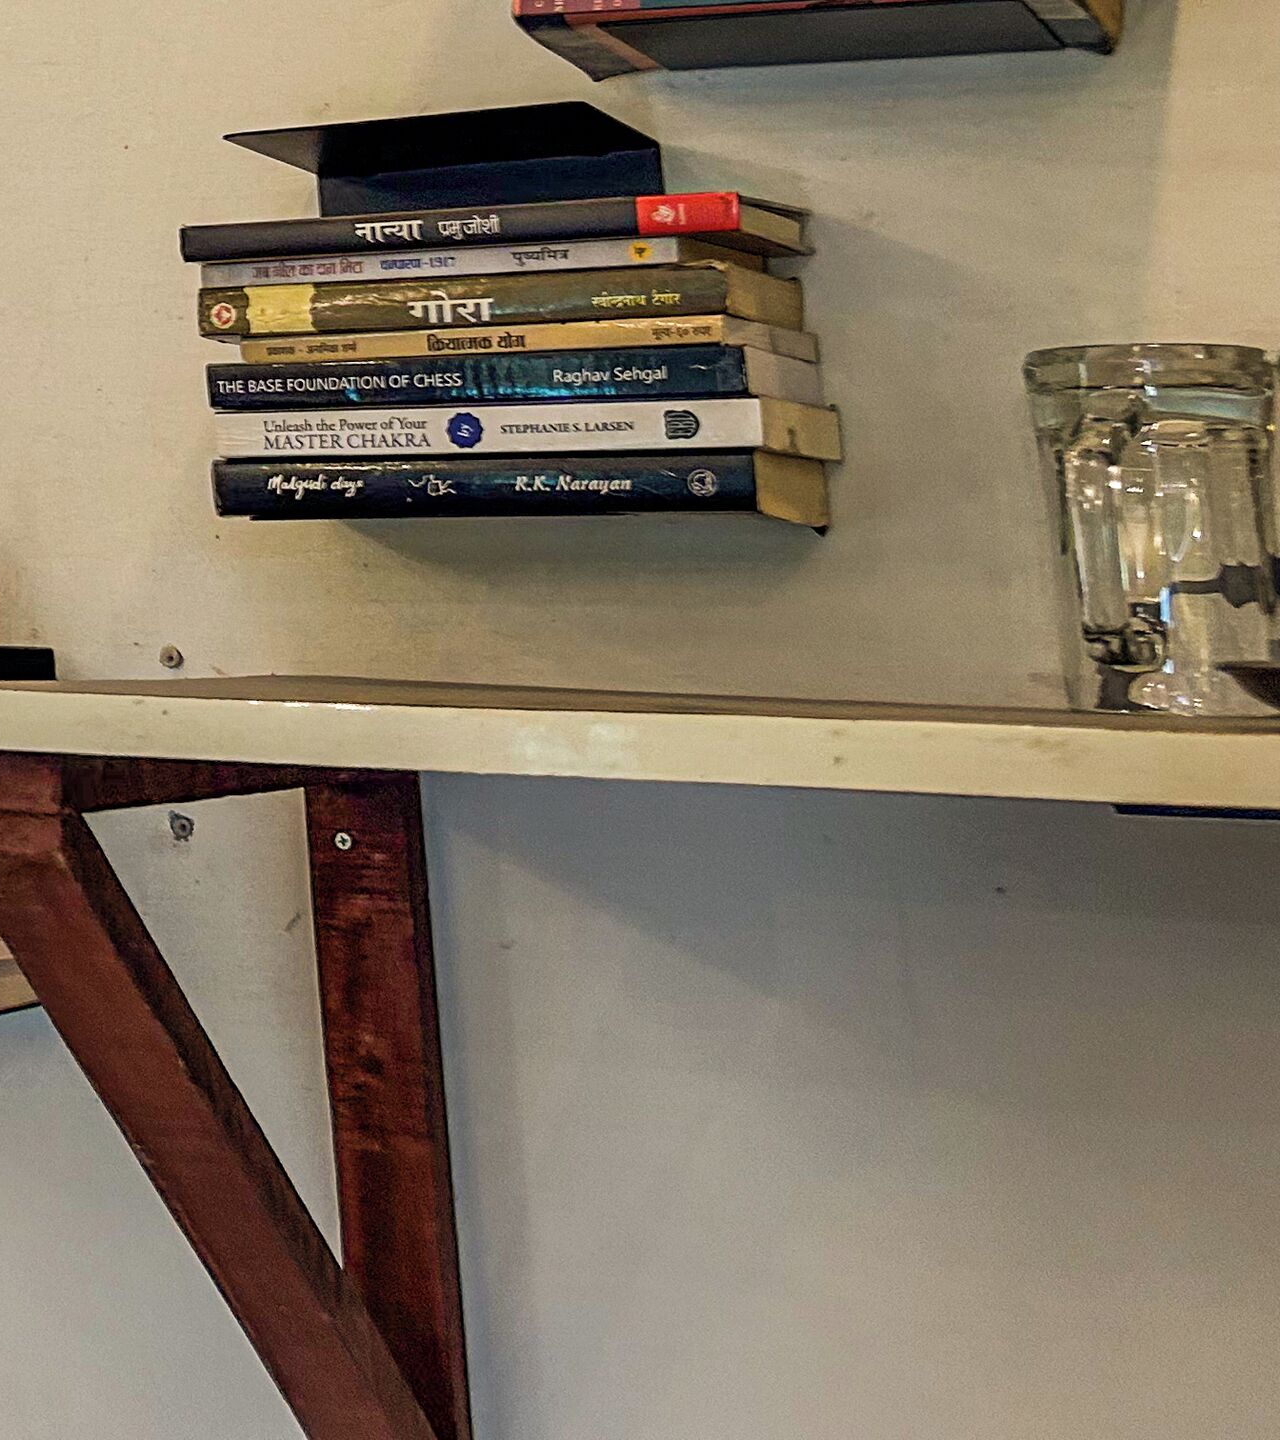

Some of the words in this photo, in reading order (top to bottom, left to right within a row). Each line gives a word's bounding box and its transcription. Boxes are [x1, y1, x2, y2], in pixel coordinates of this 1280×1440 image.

[407, 290, 494, 323] गोरा
[217, 379, 245, 394] THE
[248, 378, 284, 393] BASE
[287, 375, 386, 392] FOUNDATION
[388, 374, 411, 387] OF
[413, 373, 463, 387] CHESS
[553, 369, 610, 386] Raghav
[613, 366, 668, 384] Sehgal
[263, 419, 312, 433] Unleash
[316, 418, 336, 432] the
[339, 418, 377, 432] Power
[379, 416, 395, 430] of
[397, 416, 428, 430] Your
[500, 422, 570, 434] STEPHANIE
[572, 422, 582, 432] S.
[583, 420, 635, 432] LARSEN
[263, 434, 344, 451] MASTER
[346, 432, 431, 449] CHAKRA
[267, 474, 327, 500] Malgudi
[330, 475, 364, 497] days
[515, 476, 550, 491] R.K.
[555, 476, 633, 494] Narayan
